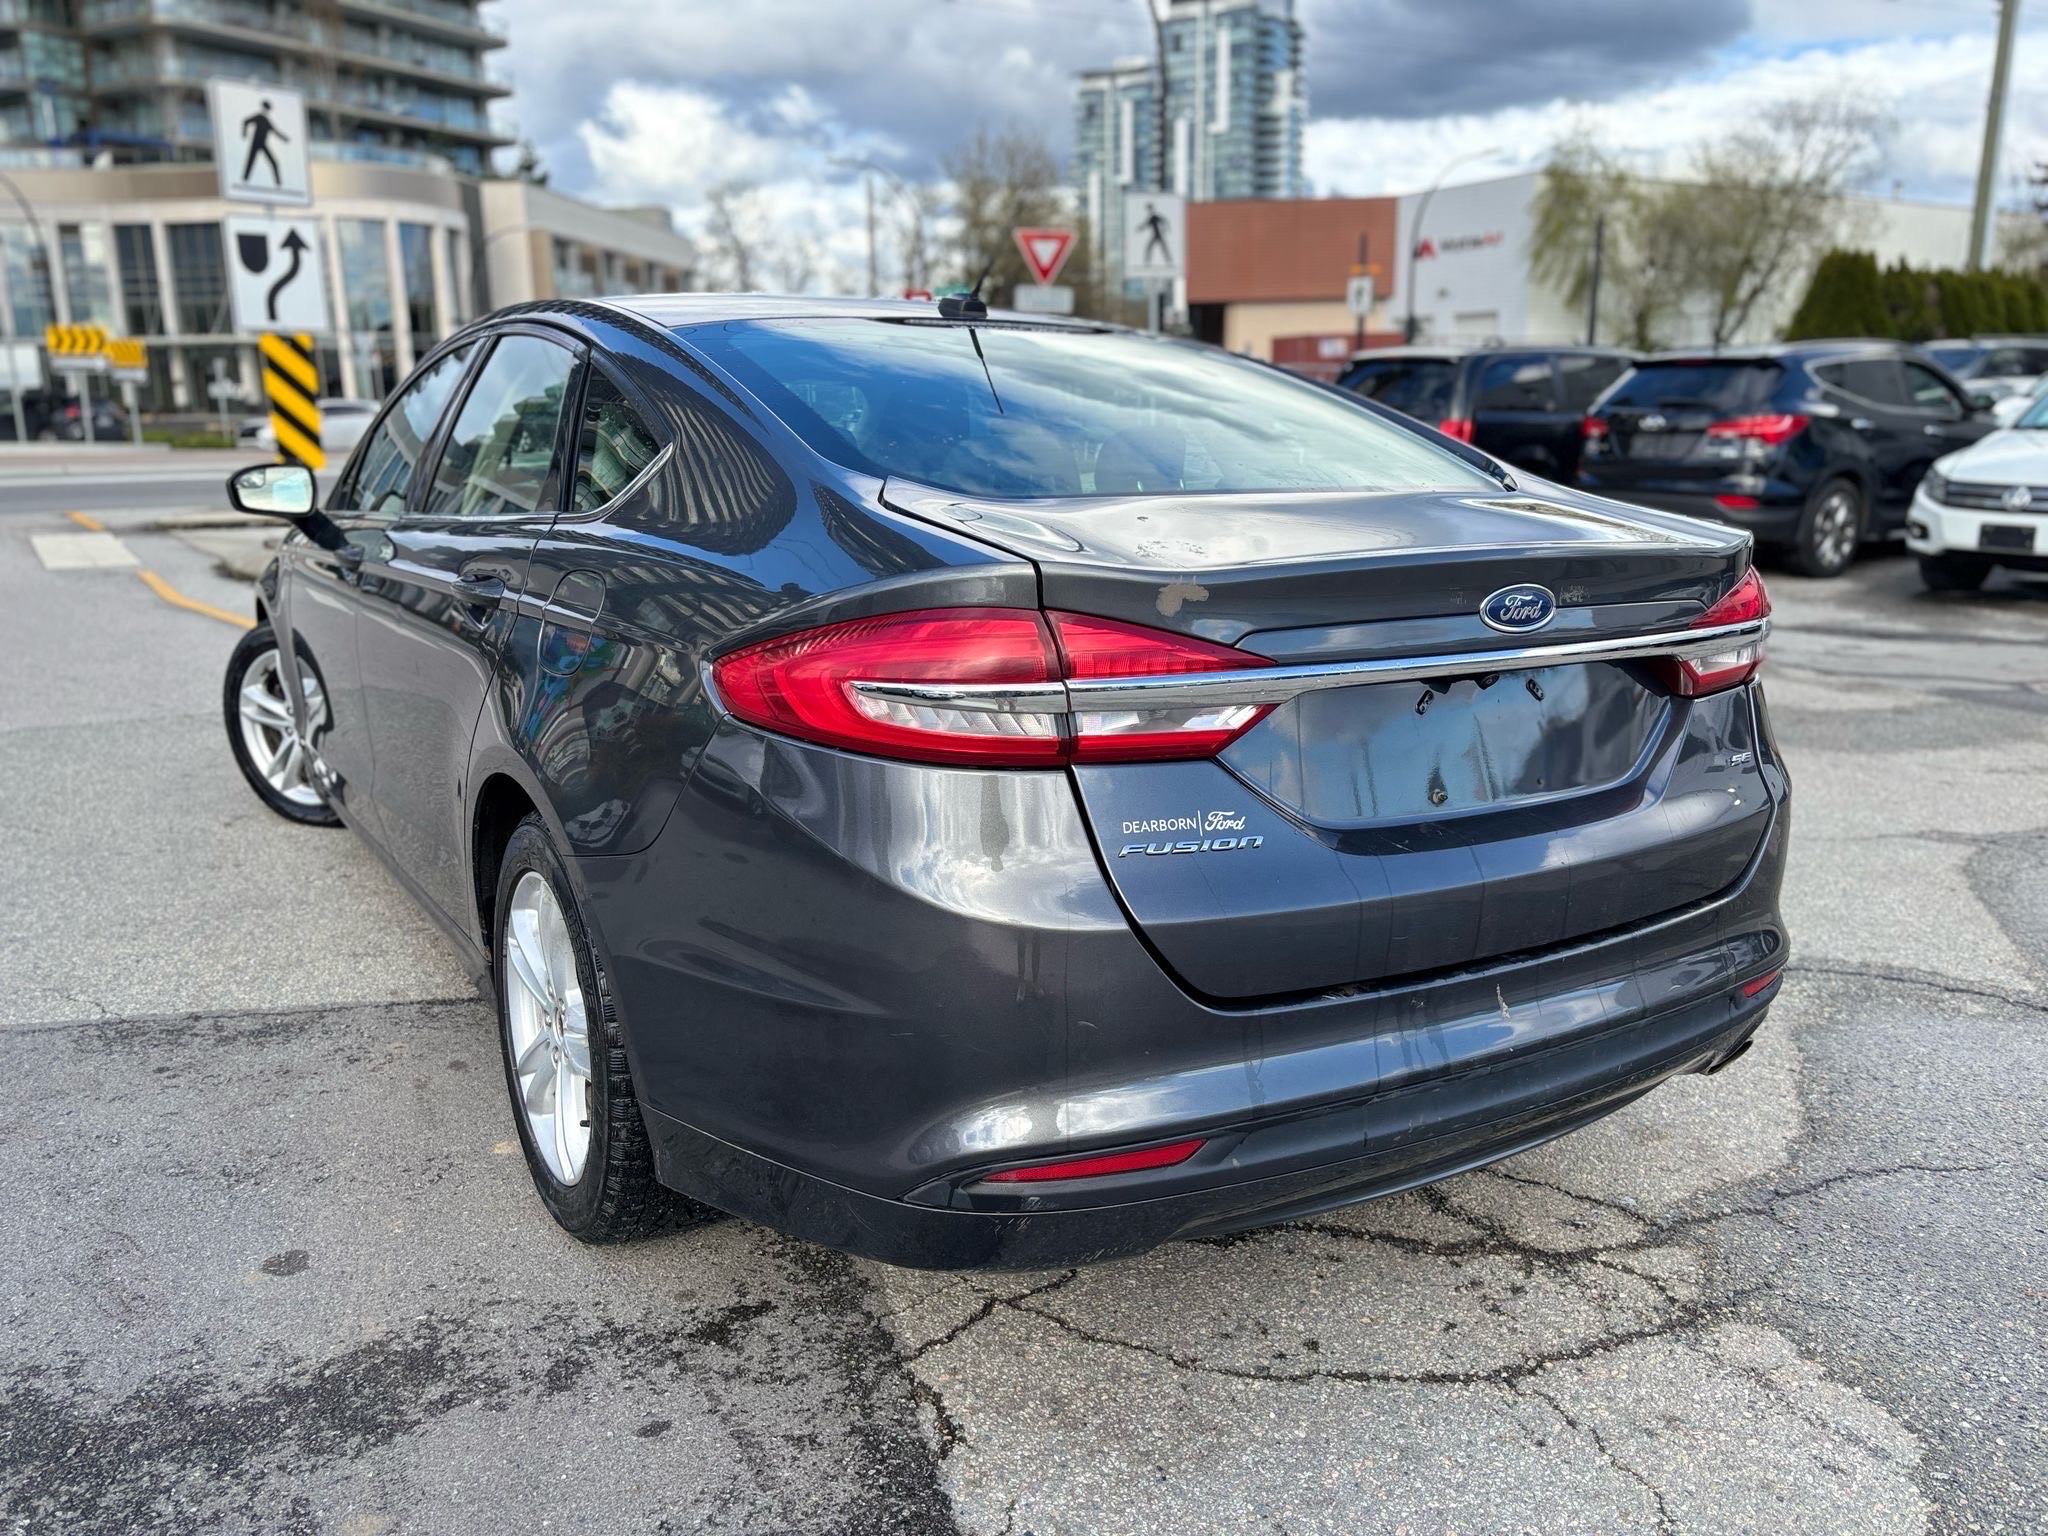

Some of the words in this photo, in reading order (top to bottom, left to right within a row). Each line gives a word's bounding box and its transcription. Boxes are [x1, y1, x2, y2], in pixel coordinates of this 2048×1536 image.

[1500, 594, 1542, 621] Ford
[1731, 751, 1752, 767] SE
[1122, 817, 1197, 834] DEARBORN
[1204, 810, 1246, 831] Ford
[1118, 835, 1264, 858] FUSION
